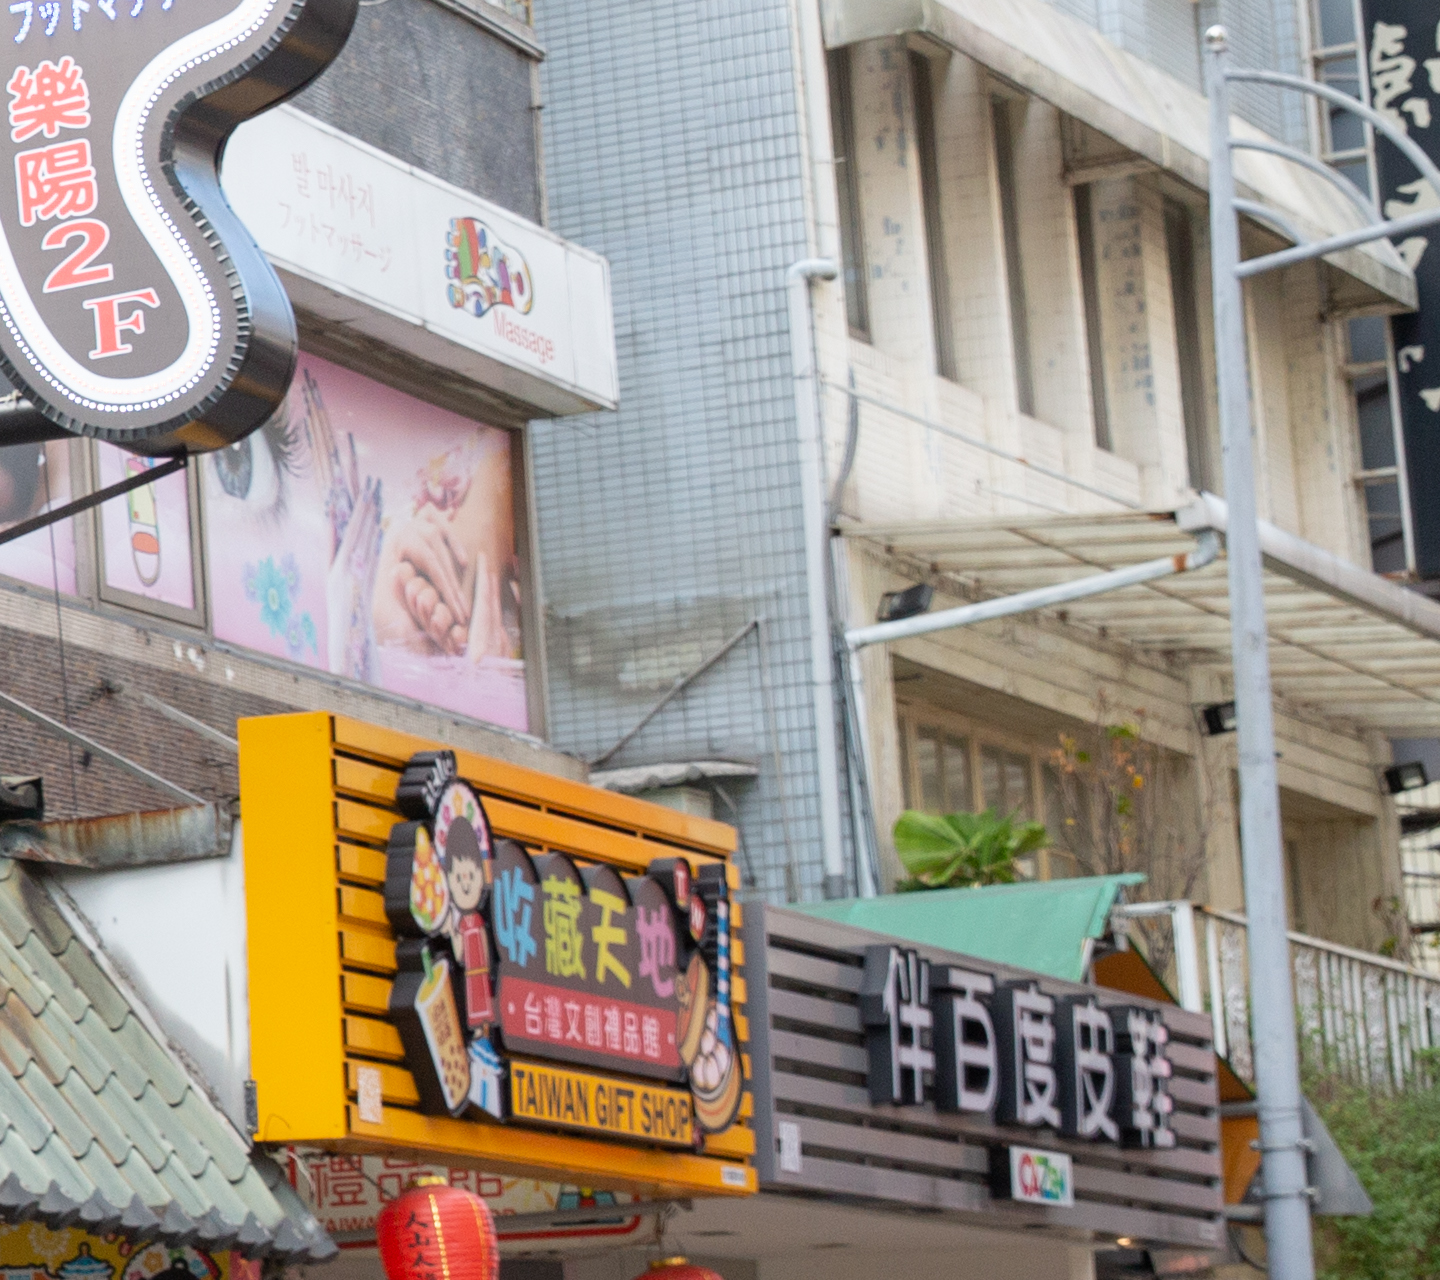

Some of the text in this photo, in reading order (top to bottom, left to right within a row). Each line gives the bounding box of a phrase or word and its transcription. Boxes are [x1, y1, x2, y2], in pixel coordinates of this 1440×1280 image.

[492, 310, 555, 365] Massage
[493, 864, 677, 1000] 收藏天地
[523, 991, 661, 1058] 台灣文創禮品館
[884, 946, 1176, 1149] 伴百度皮鞋
[515, 1070, 691, 1141] TAIWAN GIFT SHOP
